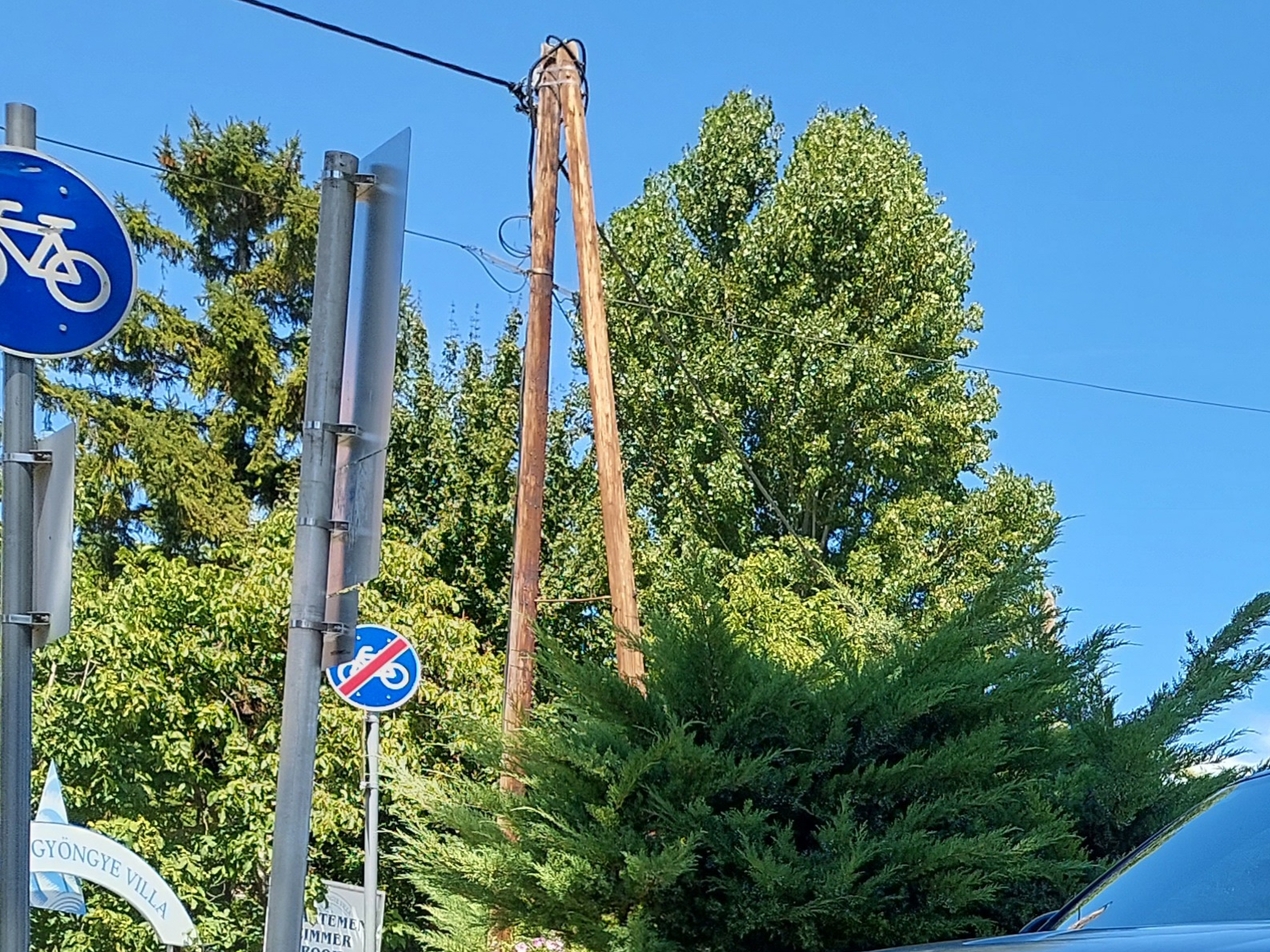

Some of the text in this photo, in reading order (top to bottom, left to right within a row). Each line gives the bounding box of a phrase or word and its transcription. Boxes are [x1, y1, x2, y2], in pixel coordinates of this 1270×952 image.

[31, 836, 169, 920] GYÖNGYE VILLA
[304, 911, 365, 932] TEMEN
[302, 928, 352, 948] IMMER
